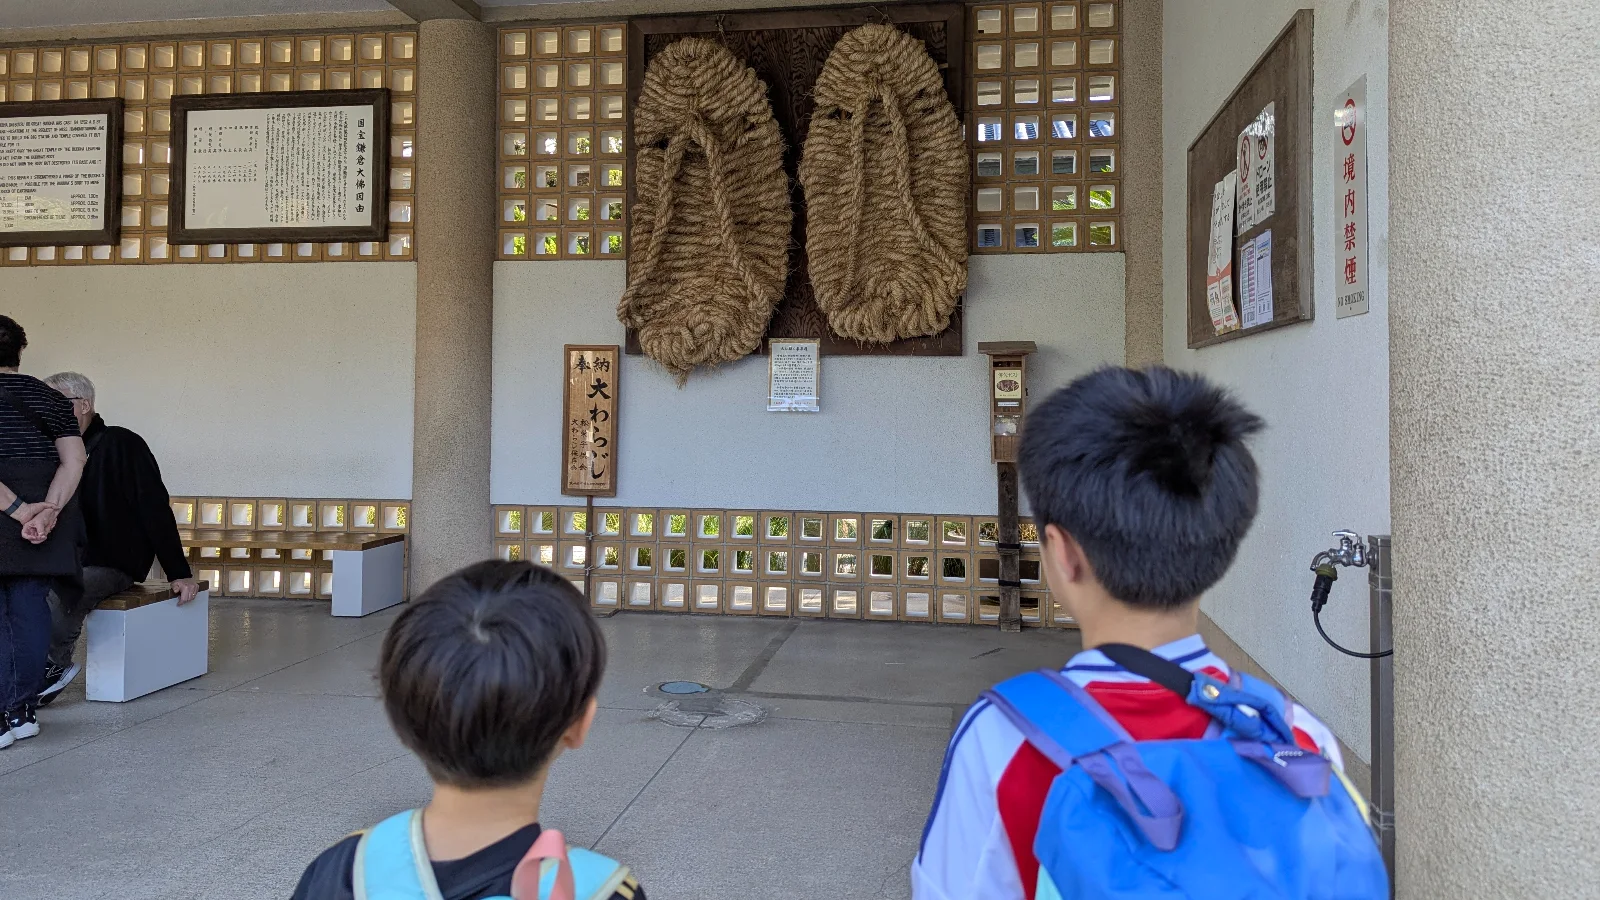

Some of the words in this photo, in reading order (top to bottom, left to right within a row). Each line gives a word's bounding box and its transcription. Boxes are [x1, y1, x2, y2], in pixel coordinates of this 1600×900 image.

[1343, 153, 1357, 285] 境内禁煙
[573, 354, 610, 374] 奉納
[588, 378, 612, 480] 大わらじ
